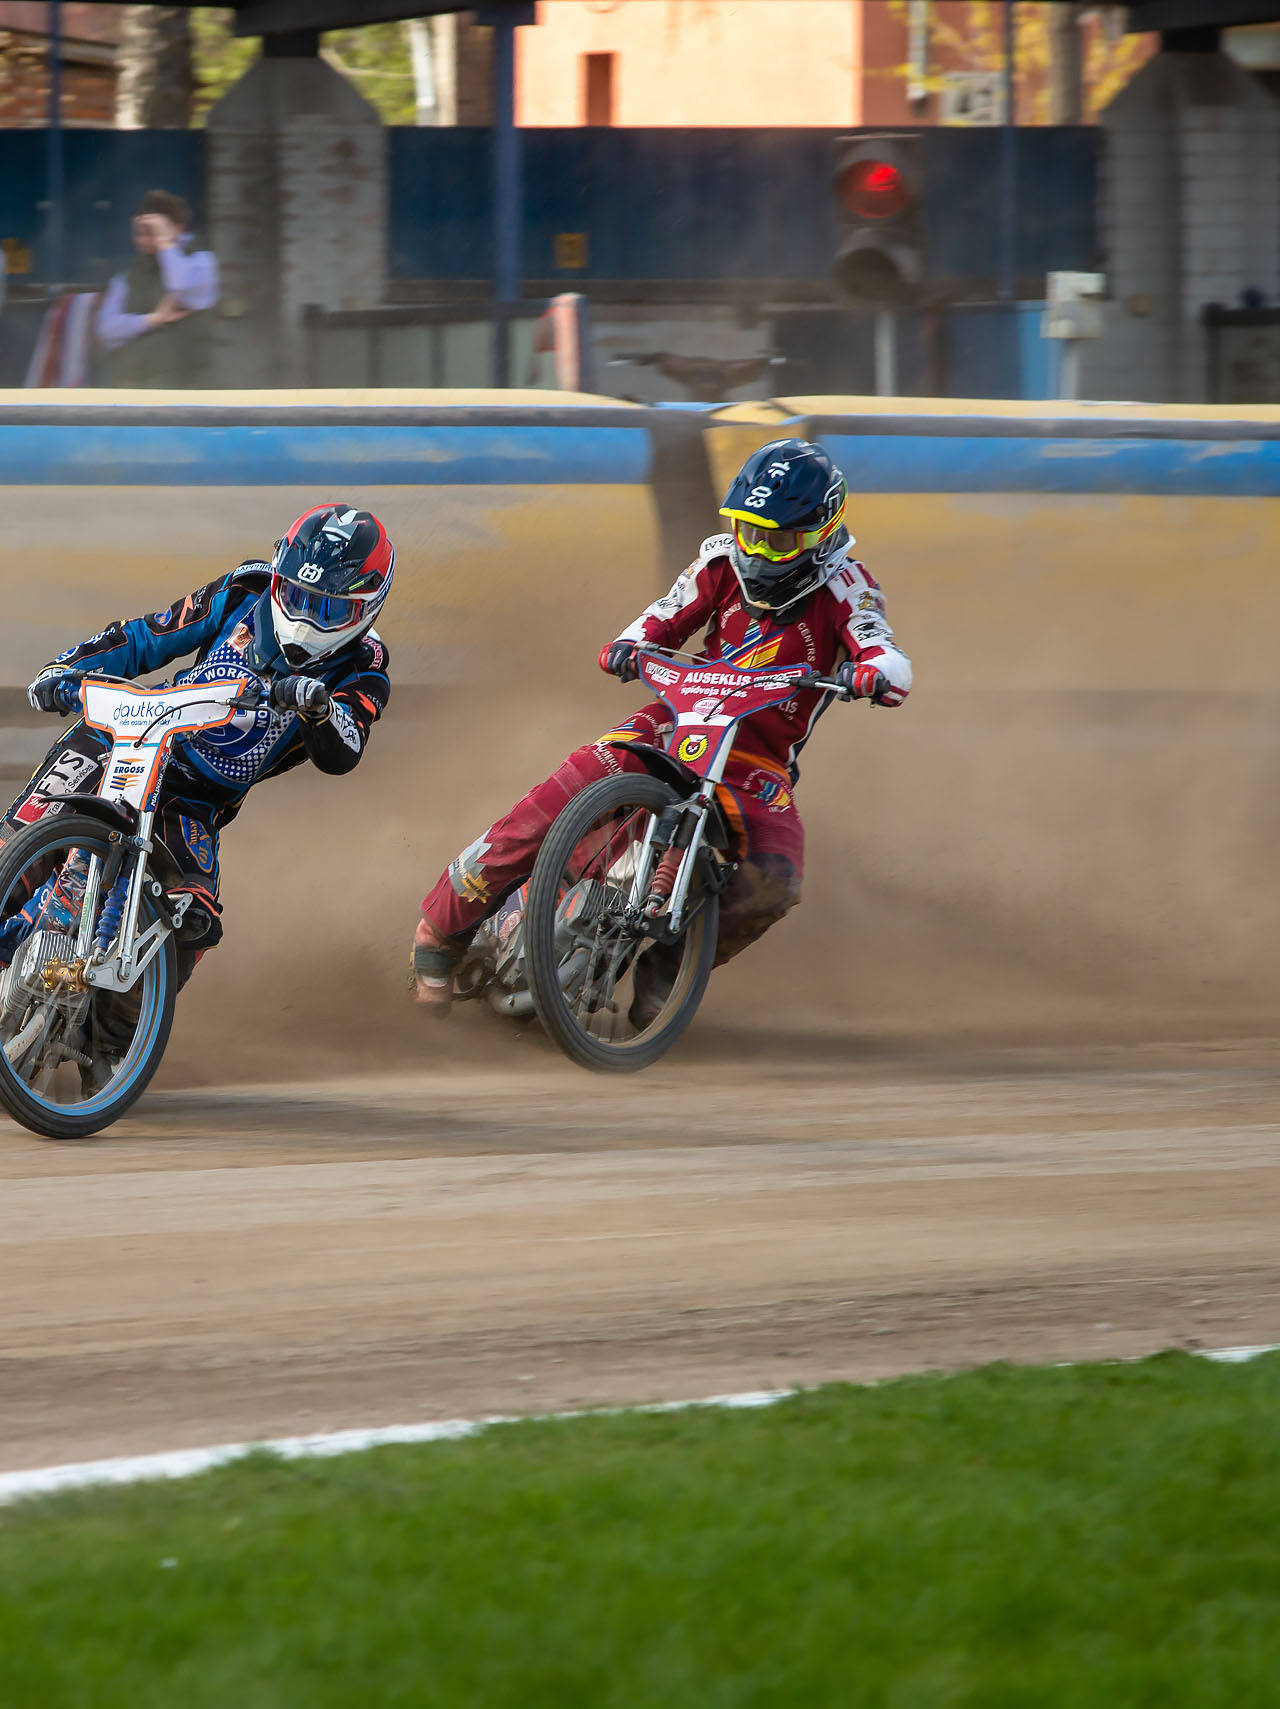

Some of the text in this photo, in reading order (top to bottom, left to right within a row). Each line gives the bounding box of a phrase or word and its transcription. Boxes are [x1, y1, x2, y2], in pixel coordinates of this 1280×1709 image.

[683, 671, 752, 687] AUSEKLIS
[68, 764, 94, 789] Services
[114, 766, 145, 774] ERGOSS
